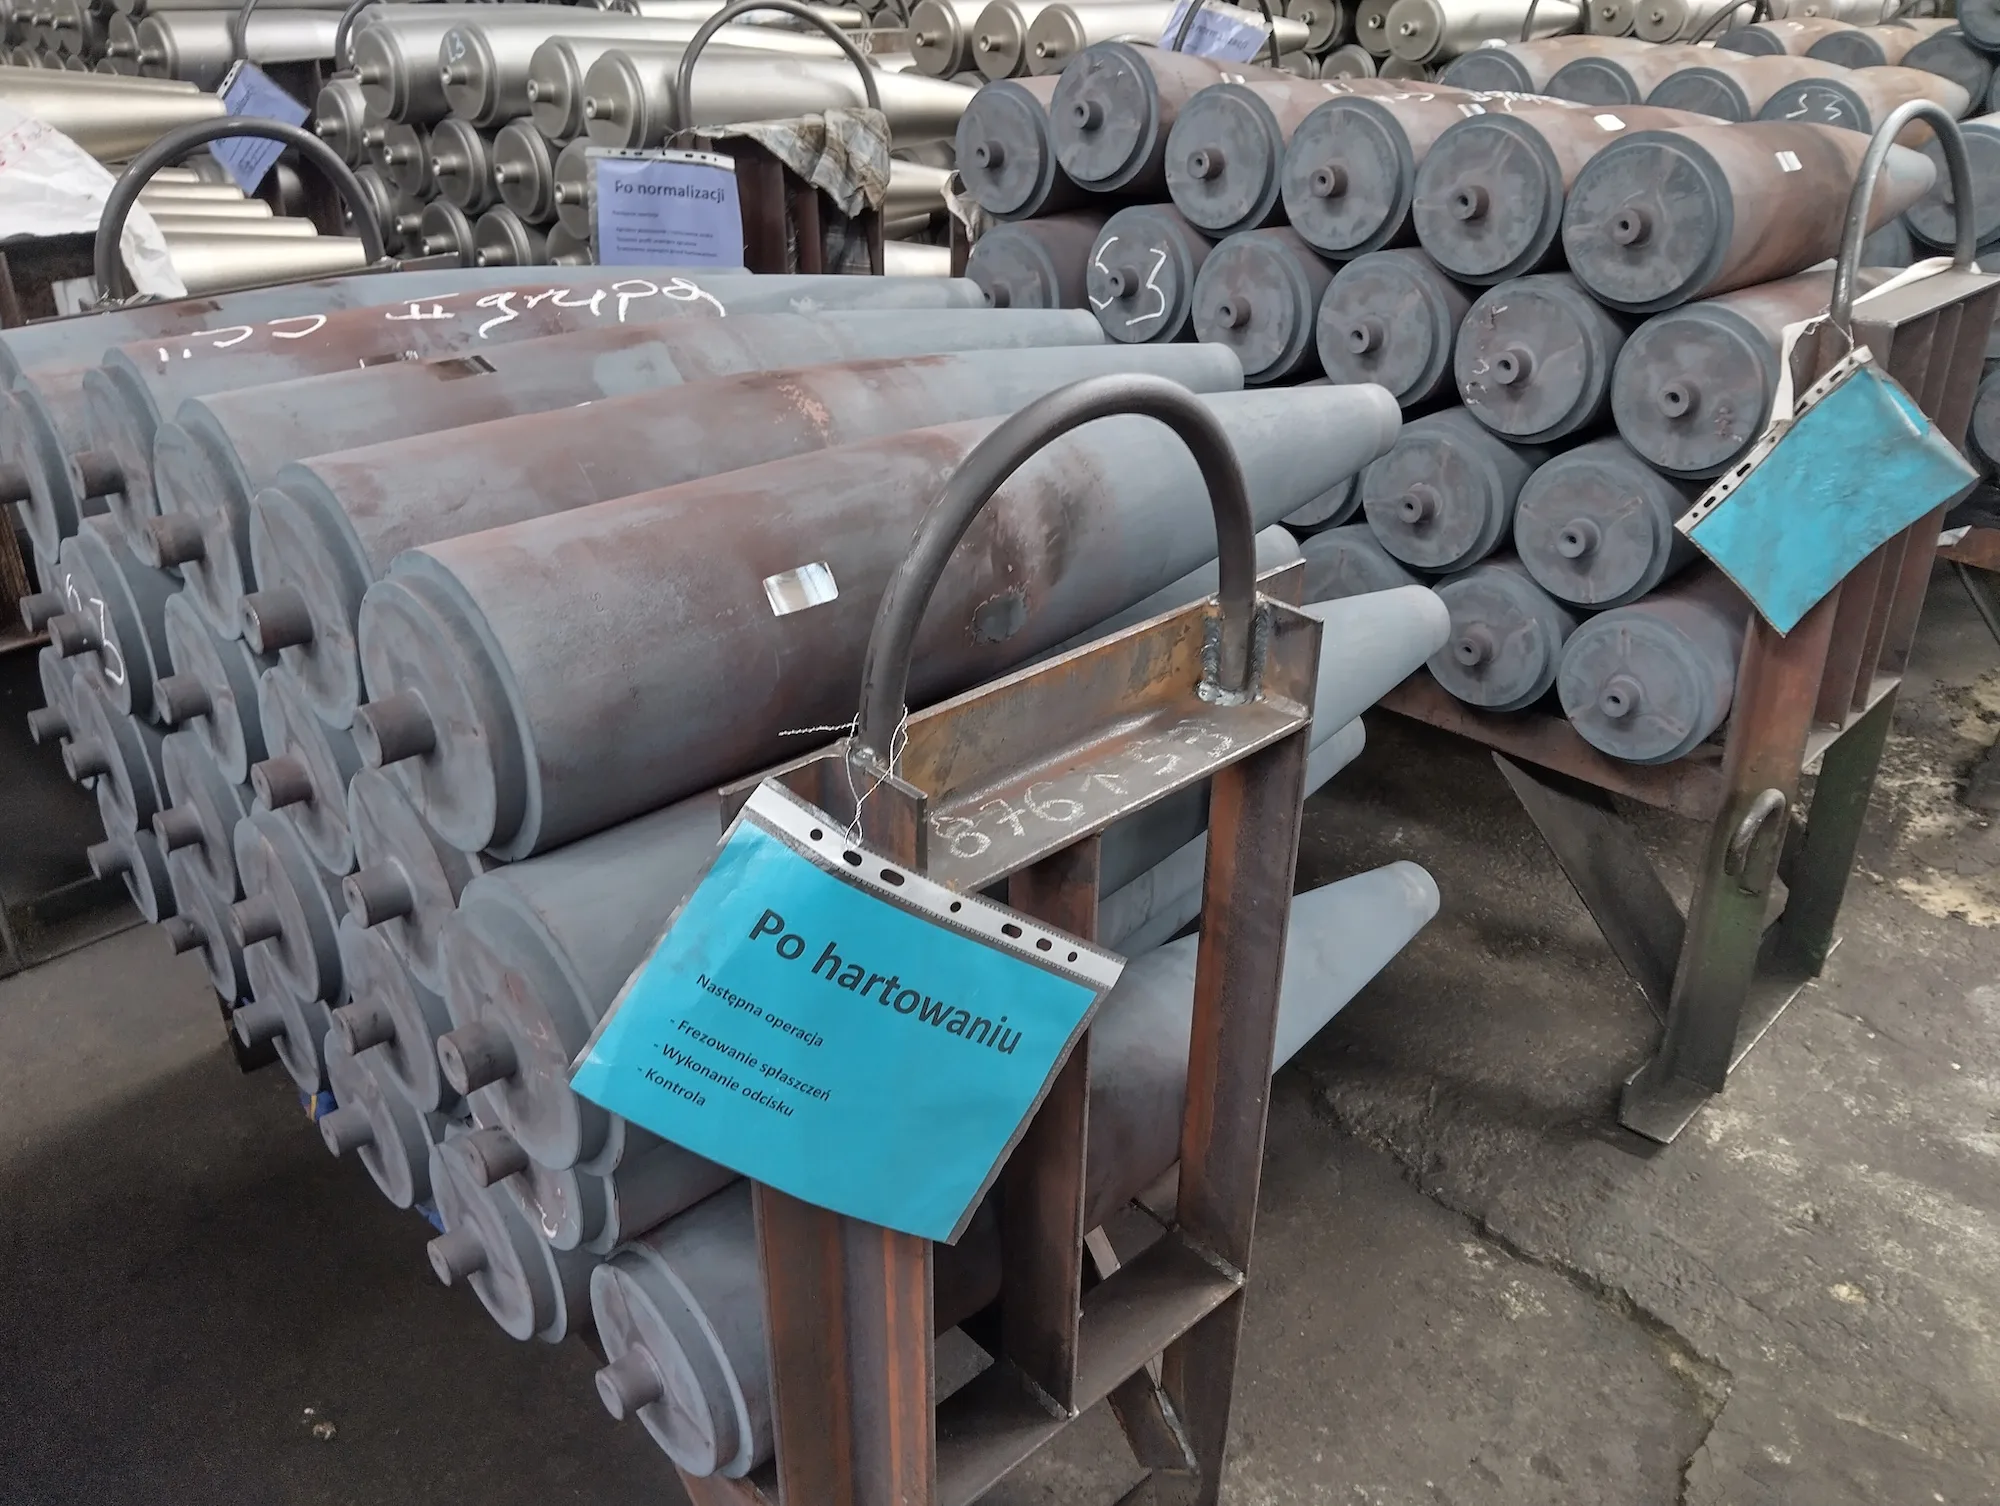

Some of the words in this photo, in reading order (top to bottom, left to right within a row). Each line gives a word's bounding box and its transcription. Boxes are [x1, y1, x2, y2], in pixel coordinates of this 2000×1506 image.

[637, 182, 725, 204] normalizacji
[696, 973, 763, 1018] Następna
[764, 1012, 824, 1048] operacja
[748, 908, 806, 961] Po
[810, 941, 1023, 1056] hartowaniu
[644, 1067, 707, 1108] Kontrola
[662, 1043, 740, 1092] Wykonanie
[741, 1085, 795, 1118] odcisku
[677, 1019, 758, 1069] Frezowanie
[759, 1061, 833, 1103] spłaszczeń
